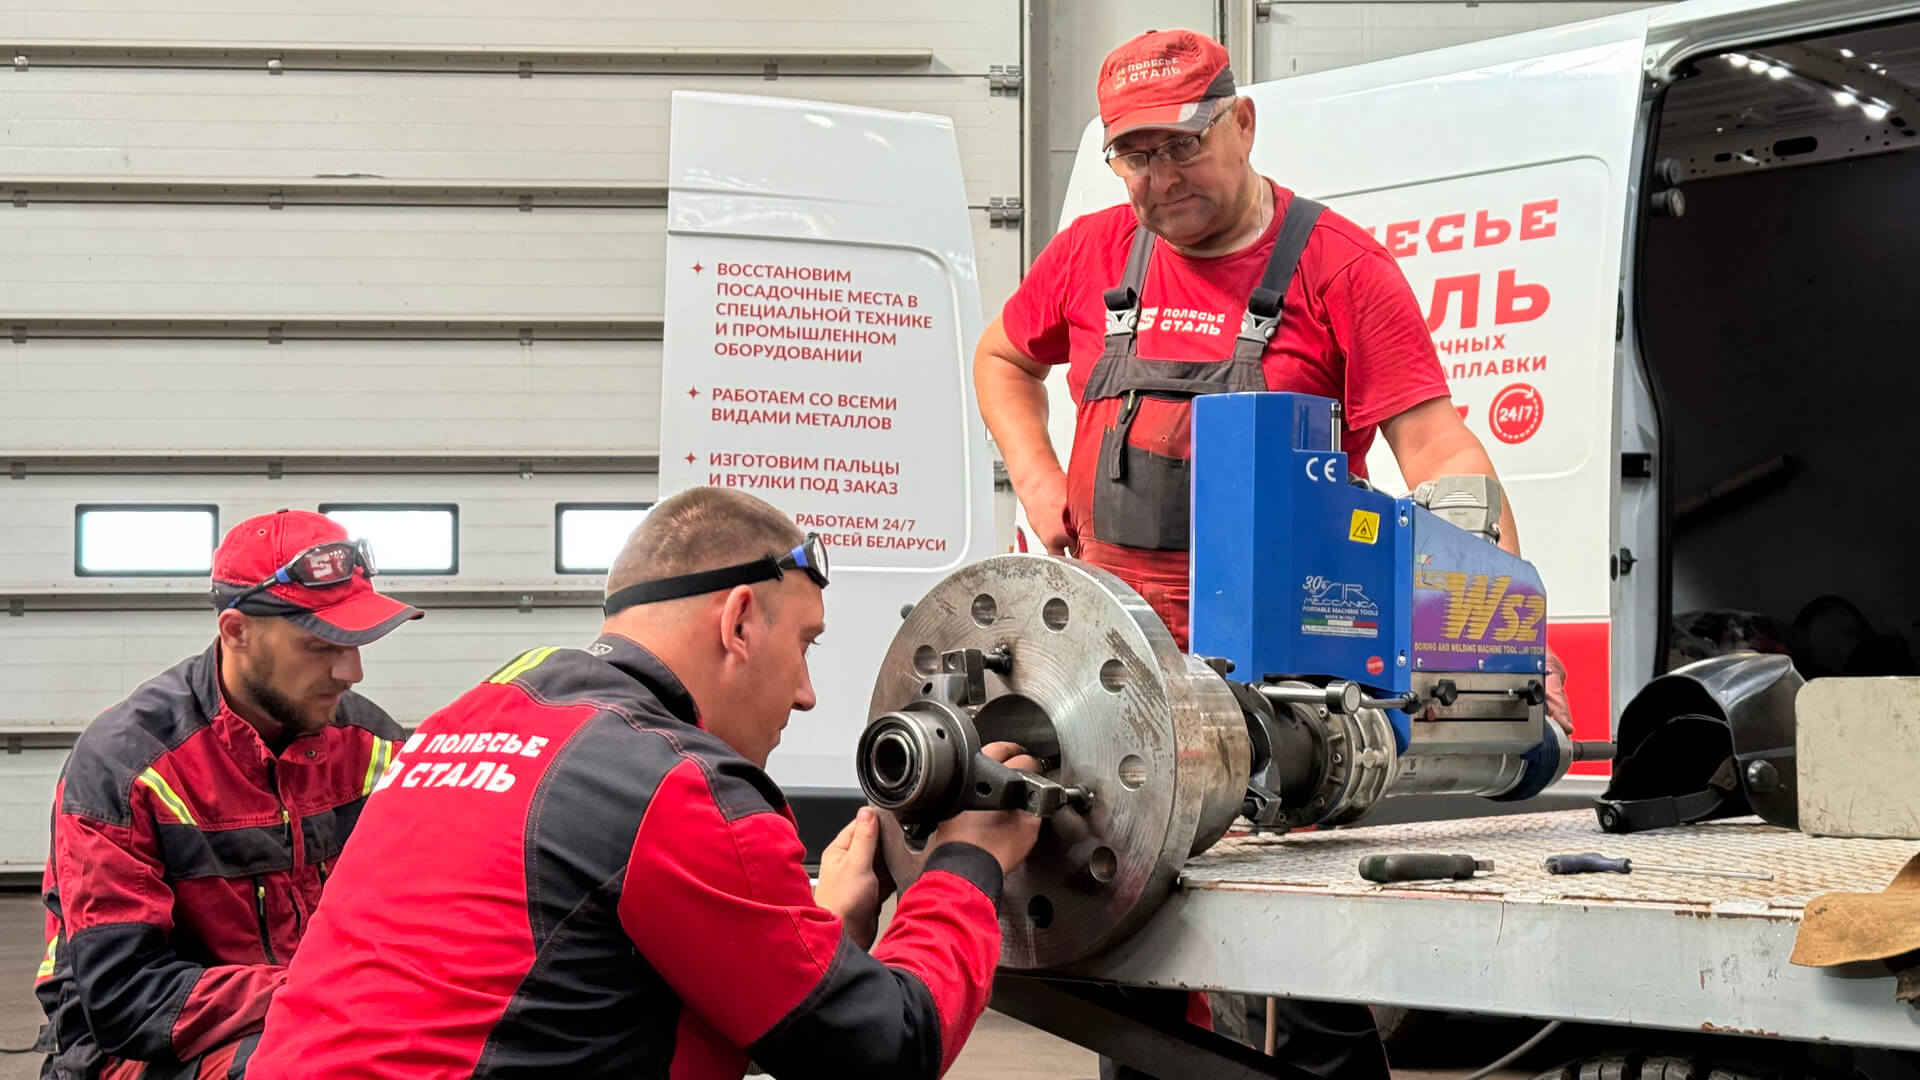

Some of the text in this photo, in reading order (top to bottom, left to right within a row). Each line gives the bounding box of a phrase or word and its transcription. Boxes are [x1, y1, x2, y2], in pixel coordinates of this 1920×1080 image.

[1127, 57, 1179, 72] ПОЛЕСЬЕ
[1129, 66, 1181, 82] СТАЛЬ
[1366, 198, 1559, 258] ЕСЬЕ
[717, 263, 851, 283] ВОССТАНОВИМ
[717, 283, 918, 308] ПОСАДОЧНЫЕ МЕСТА В
[1425, 268, 1551, 333] ЛЬ
[715, 302, 933, 329] СПЕЦИАЛЬНОЙ ТЕХНИКЕ
[1162, 308, 1225, 323] ПОЛЕСЬЕ
[715, 323, 897, 346] И ПРОМЫШЛЕННОМ
[1160, 320, 1221, 335] СТАЛЬ
[714, 343, 862, 363] ОБОРУДОВАНИИ
[1434, 334, 1507, 355] ЧНЫХ
[712, 388, 897, 411] РАБОТАЕМ СО ВСЕМИ
[711, 408, 892, 430] ВИДАМИ МЕТАЛЛОВ
[1499, 405, 1533, 422] 24/7
[709, 452, 900, 475] ИЗГОТОВИМ ПАЛЬЦЫ
[1306, 456, 1336, 482] CE
[708, 473, 898, 495] И ВТУЛКИ ПОД ЗАКАЗ
[795, 513, 916, 532] РАБОТАЕМ 24/7
[823, 532, 946, 551] ВСЕЙ БЕЛАРУСИ
[423, 733, 549, 757] ПОЛЕСЬЕ
[401, 761, 516, 793] СТАЛЬ
